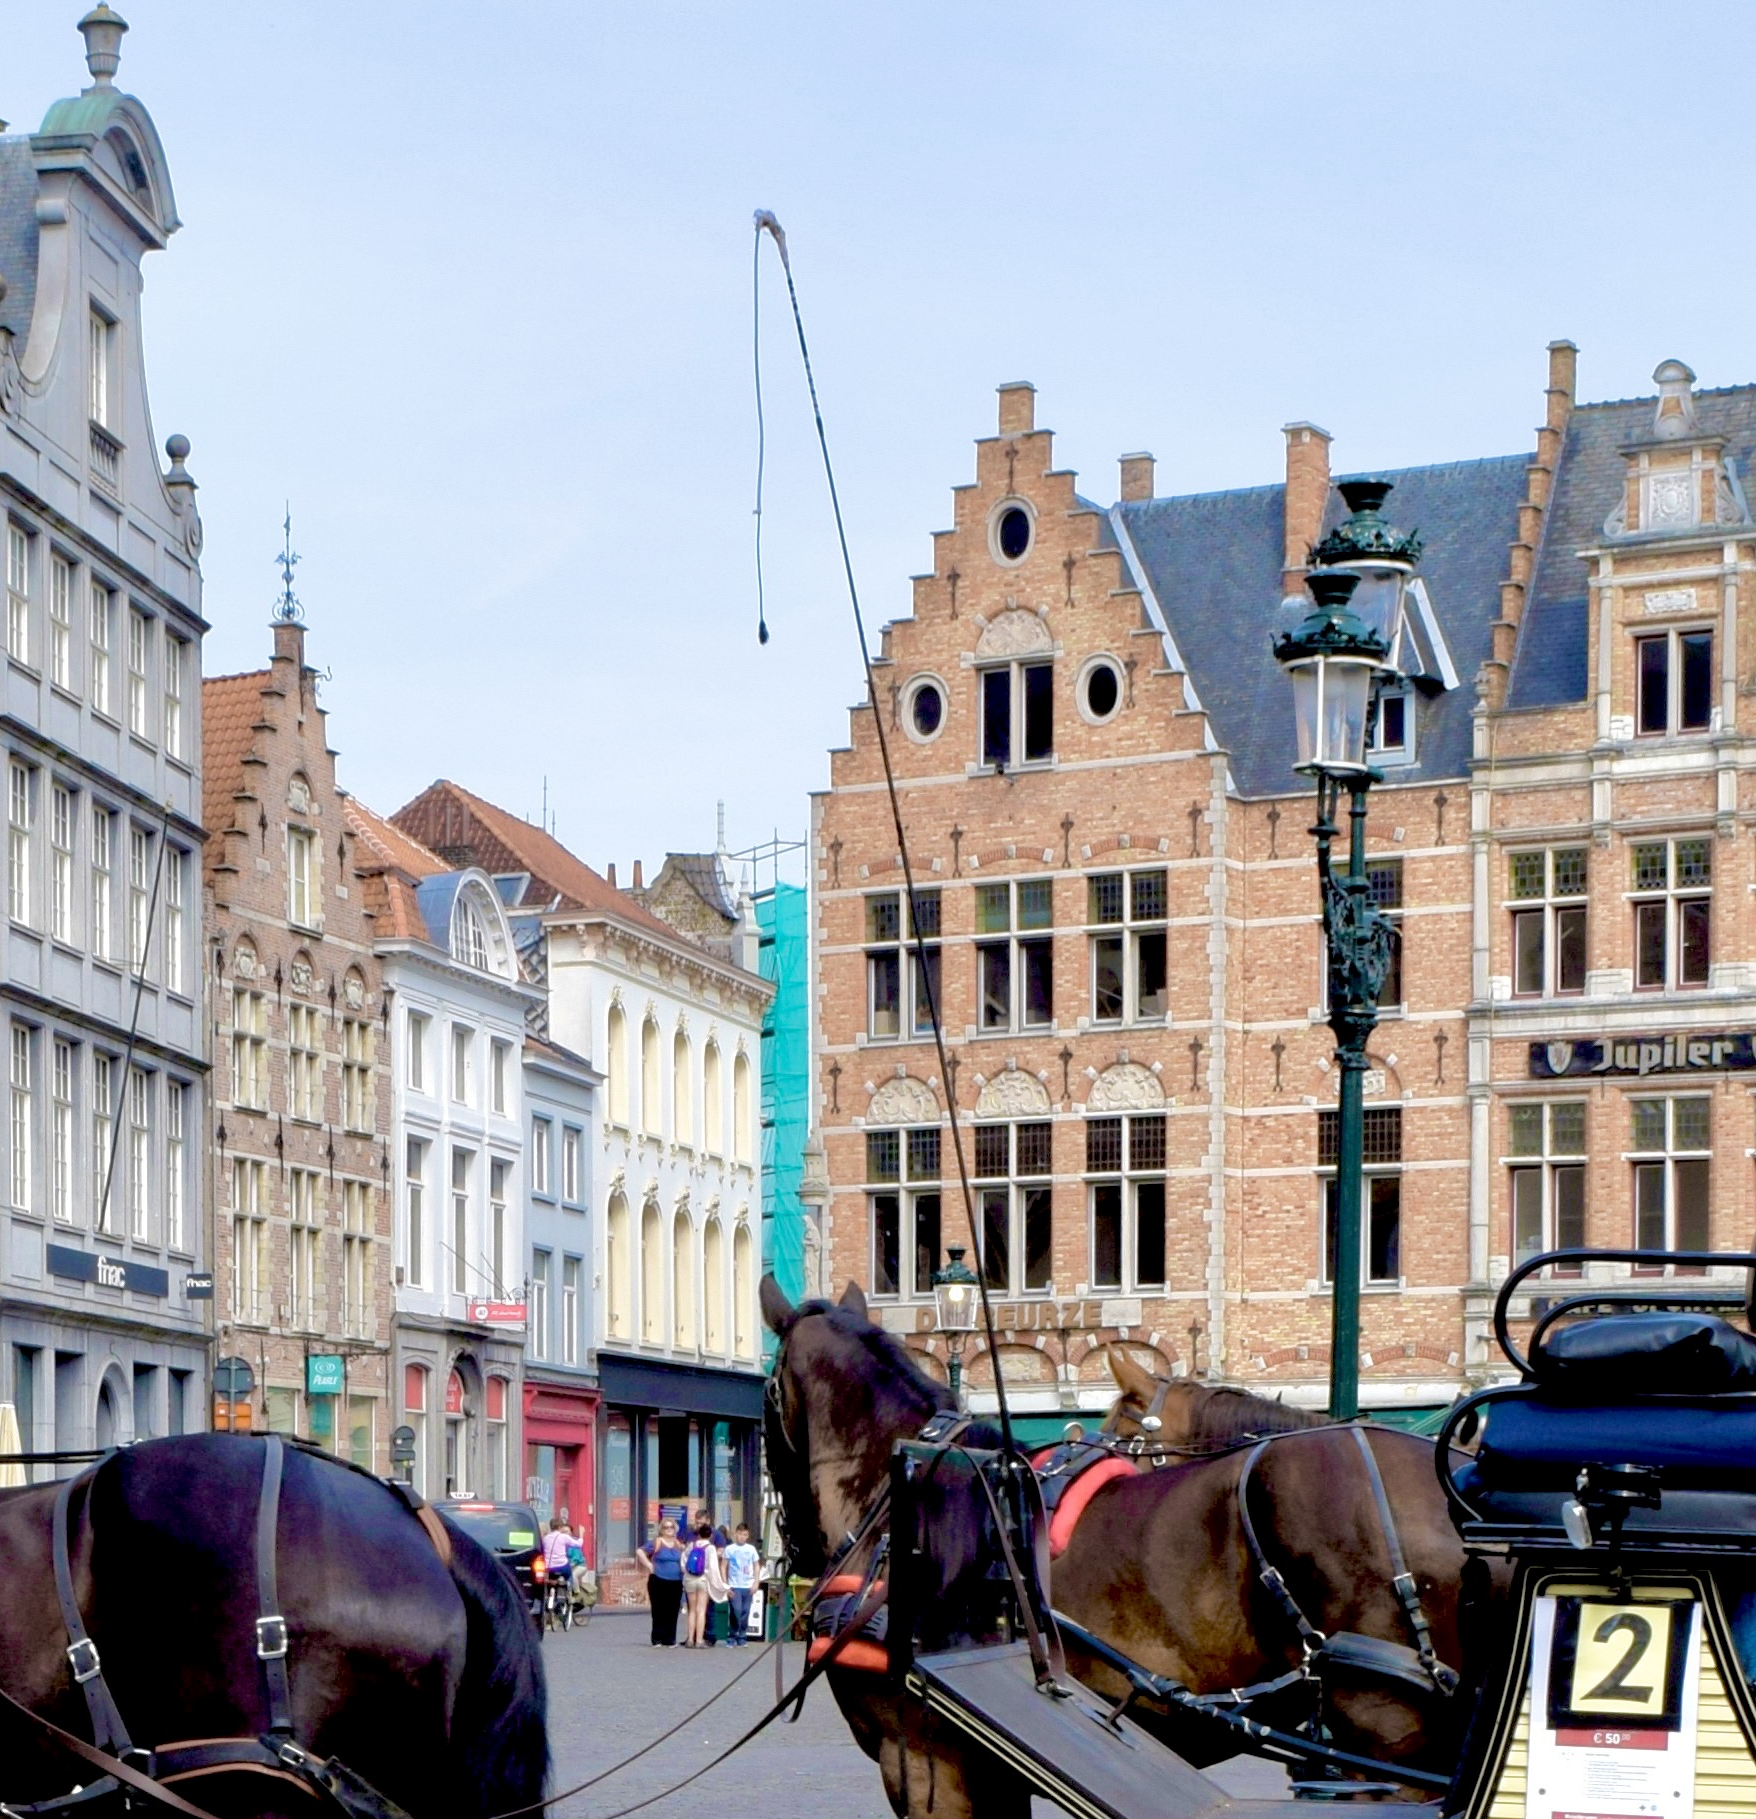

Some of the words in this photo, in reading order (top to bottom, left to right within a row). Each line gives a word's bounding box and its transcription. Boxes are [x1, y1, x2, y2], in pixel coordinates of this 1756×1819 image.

[1590, 1034, 1734, 1076] Jupiler
[97, 1255, 126, 1288] fnac
[186, 1278, 212, 1288] fnac
[1579, 1612, 1653, 1705] 2
